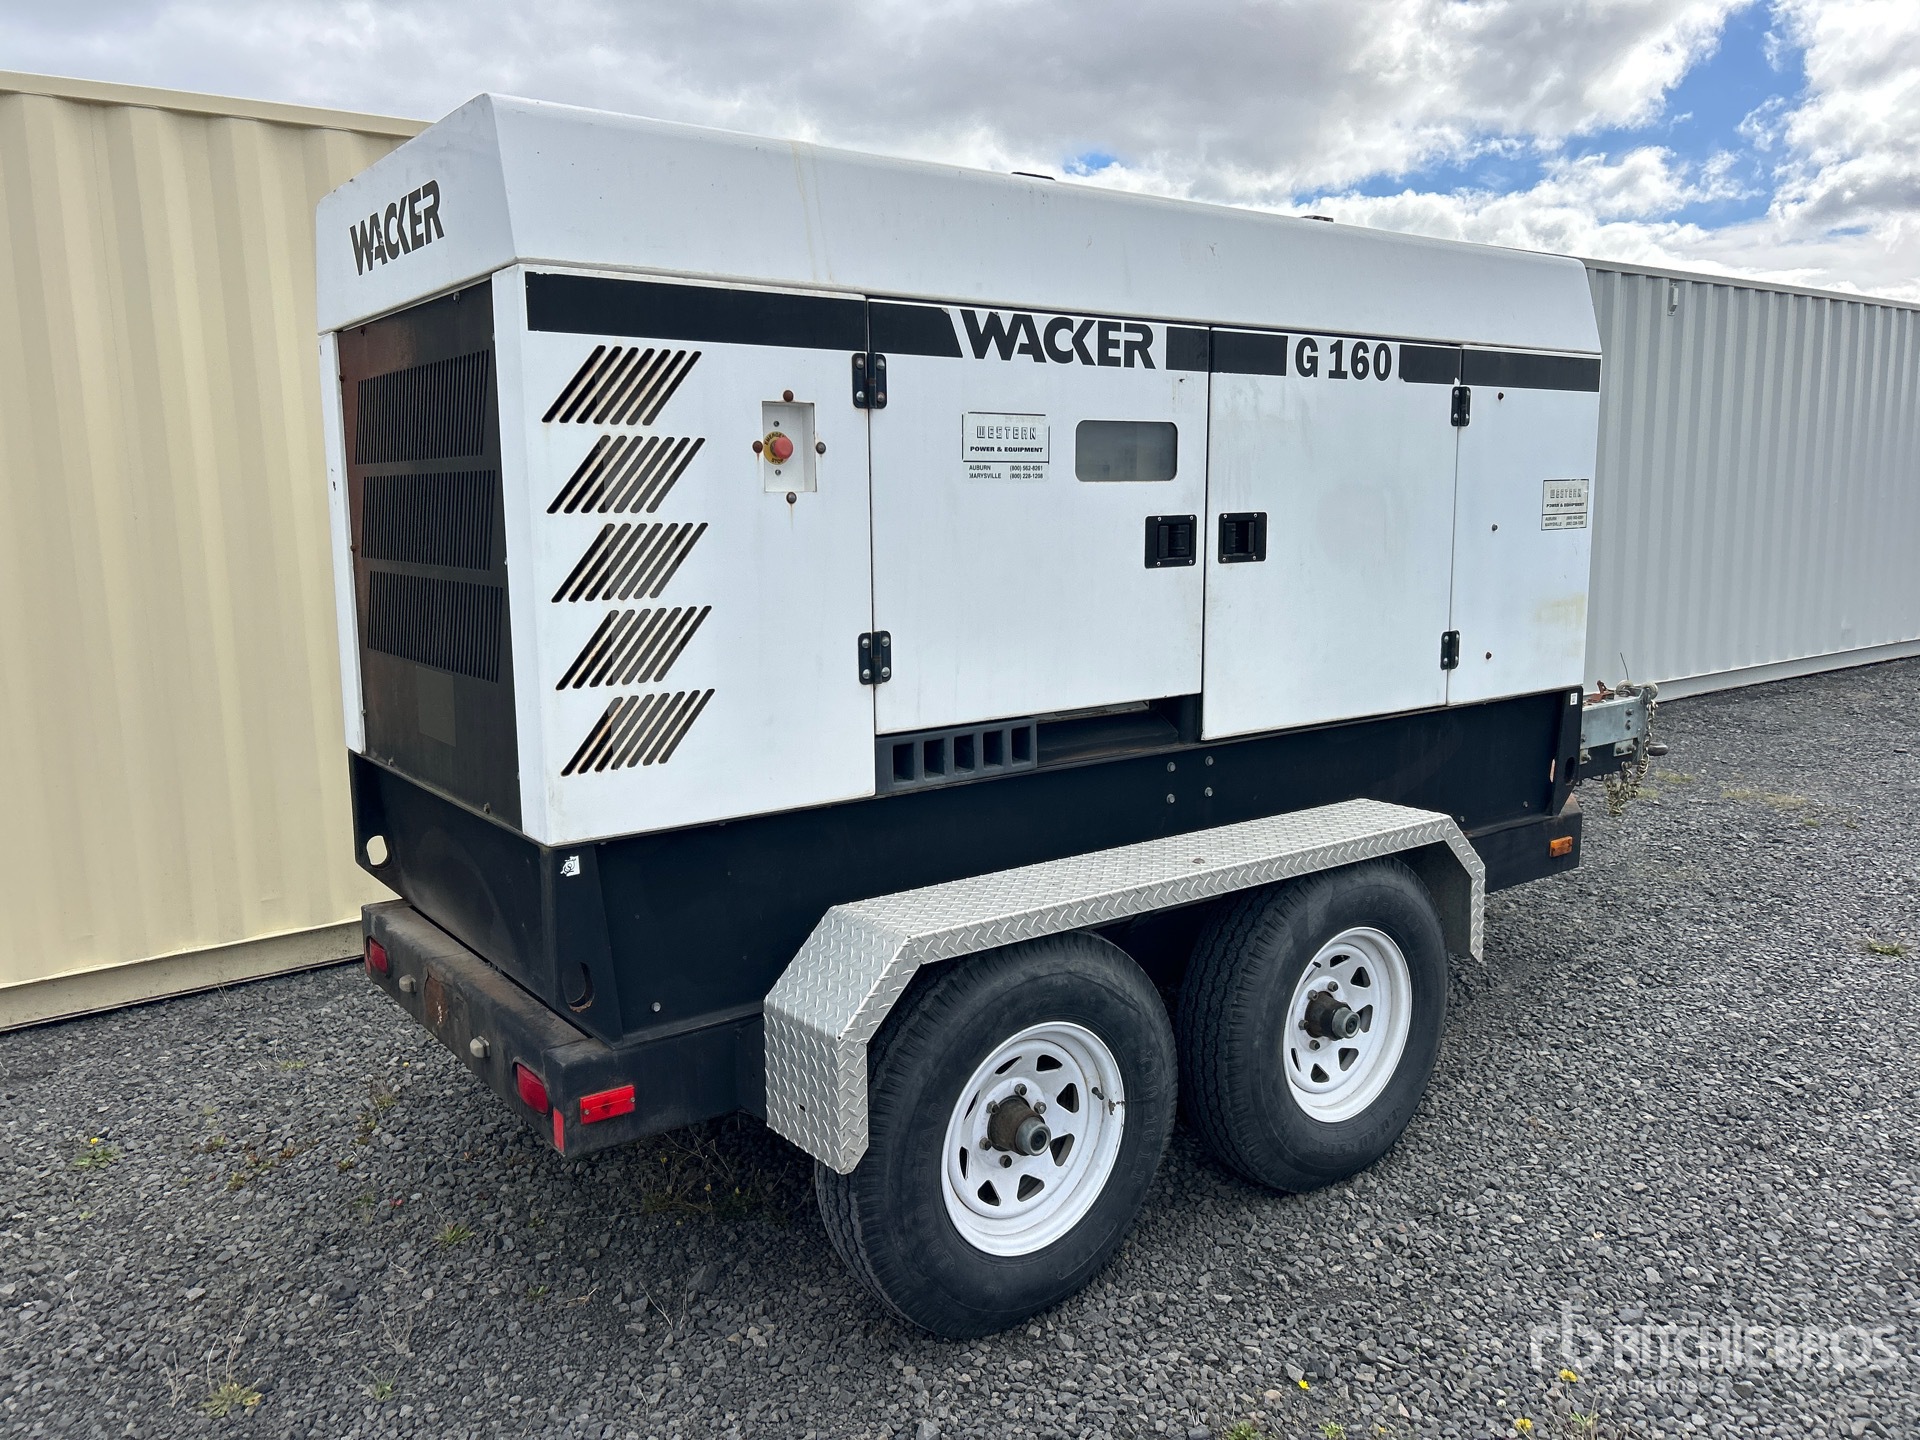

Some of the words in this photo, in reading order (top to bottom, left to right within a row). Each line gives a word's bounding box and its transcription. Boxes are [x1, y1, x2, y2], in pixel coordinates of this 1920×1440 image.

[349, 180, 444, 276] WACKER
[960, 309, 1156, 370] WACKER
[1295, 337, 1320, 378] G
[1328, 339, 1392, 382] 160
[976, 426, 1036, 440] WESTERN
